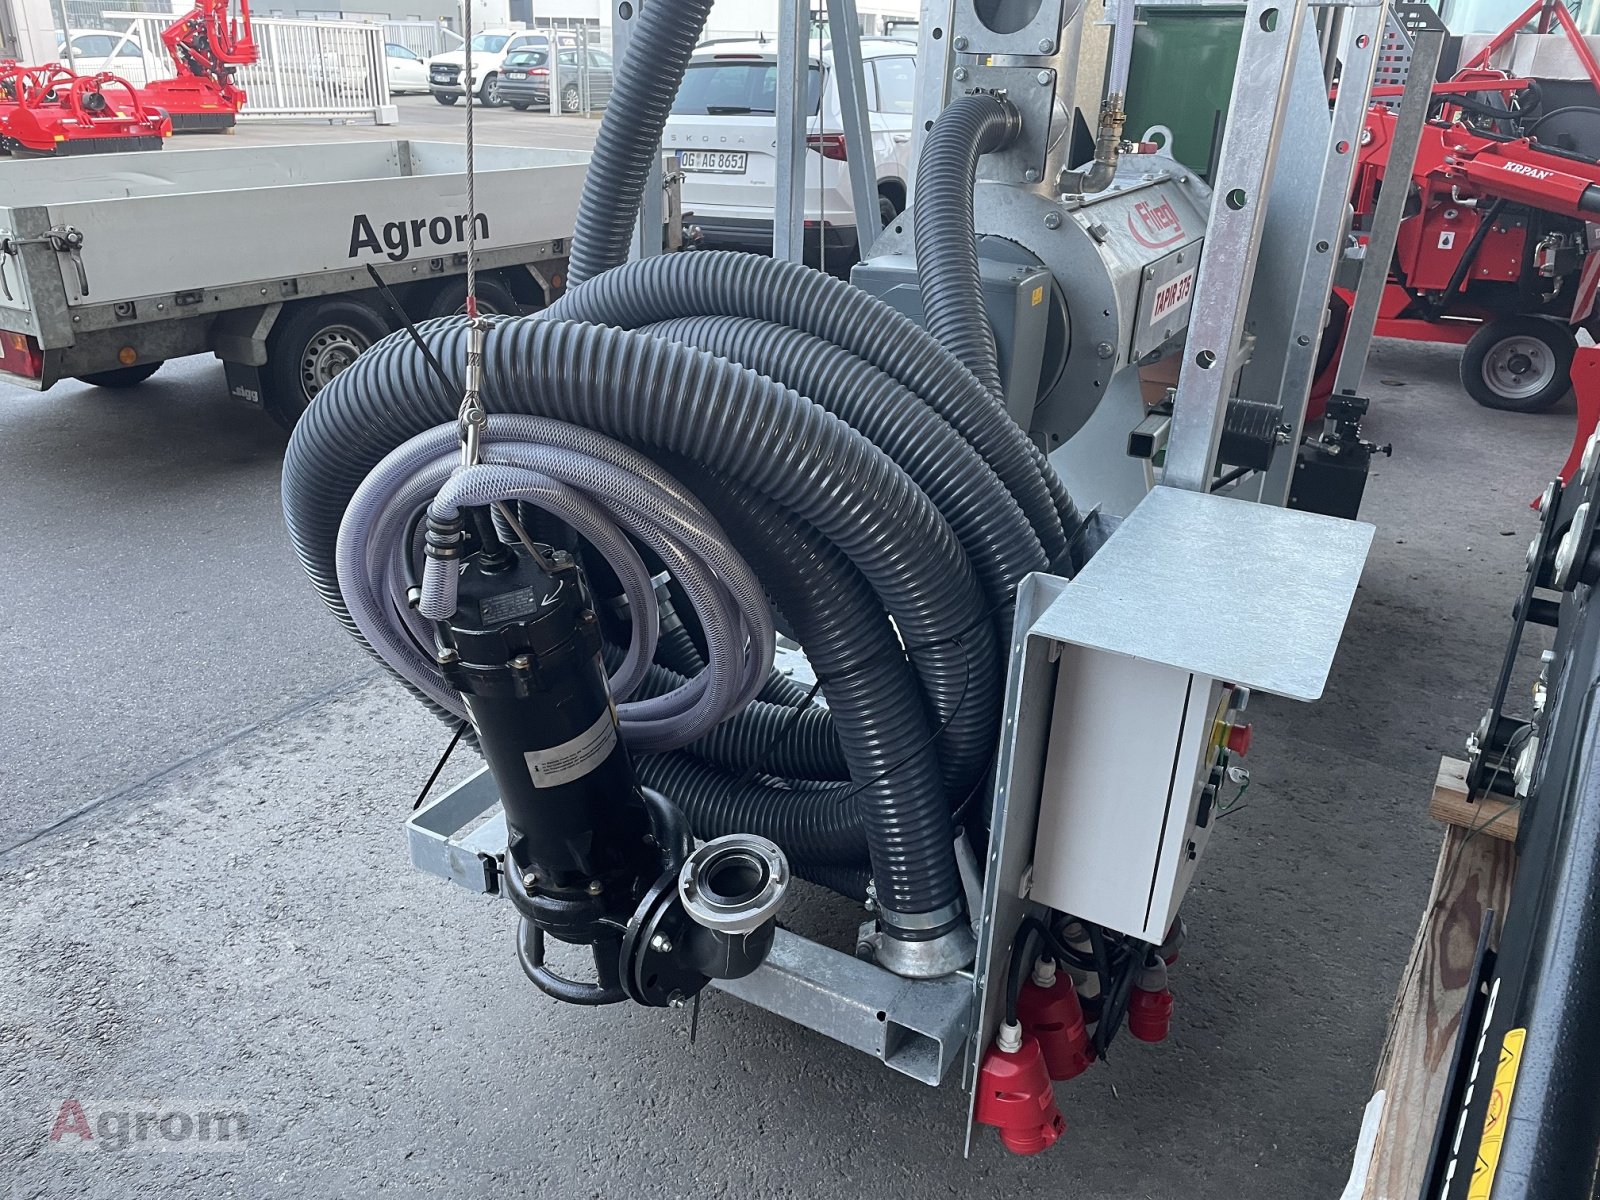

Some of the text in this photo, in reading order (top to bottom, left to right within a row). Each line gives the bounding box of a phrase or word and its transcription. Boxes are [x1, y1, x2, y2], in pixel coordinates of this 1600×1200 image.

[681, 152, 744, 169] OG AG 8651
[1503, 161, 1549, 180] KRPAN
[1134, 194, 1182, 235] Fliegl
[348, 212, 490, 262] Agrom
[1154, 274, 1192, 317] TAPIR 375
